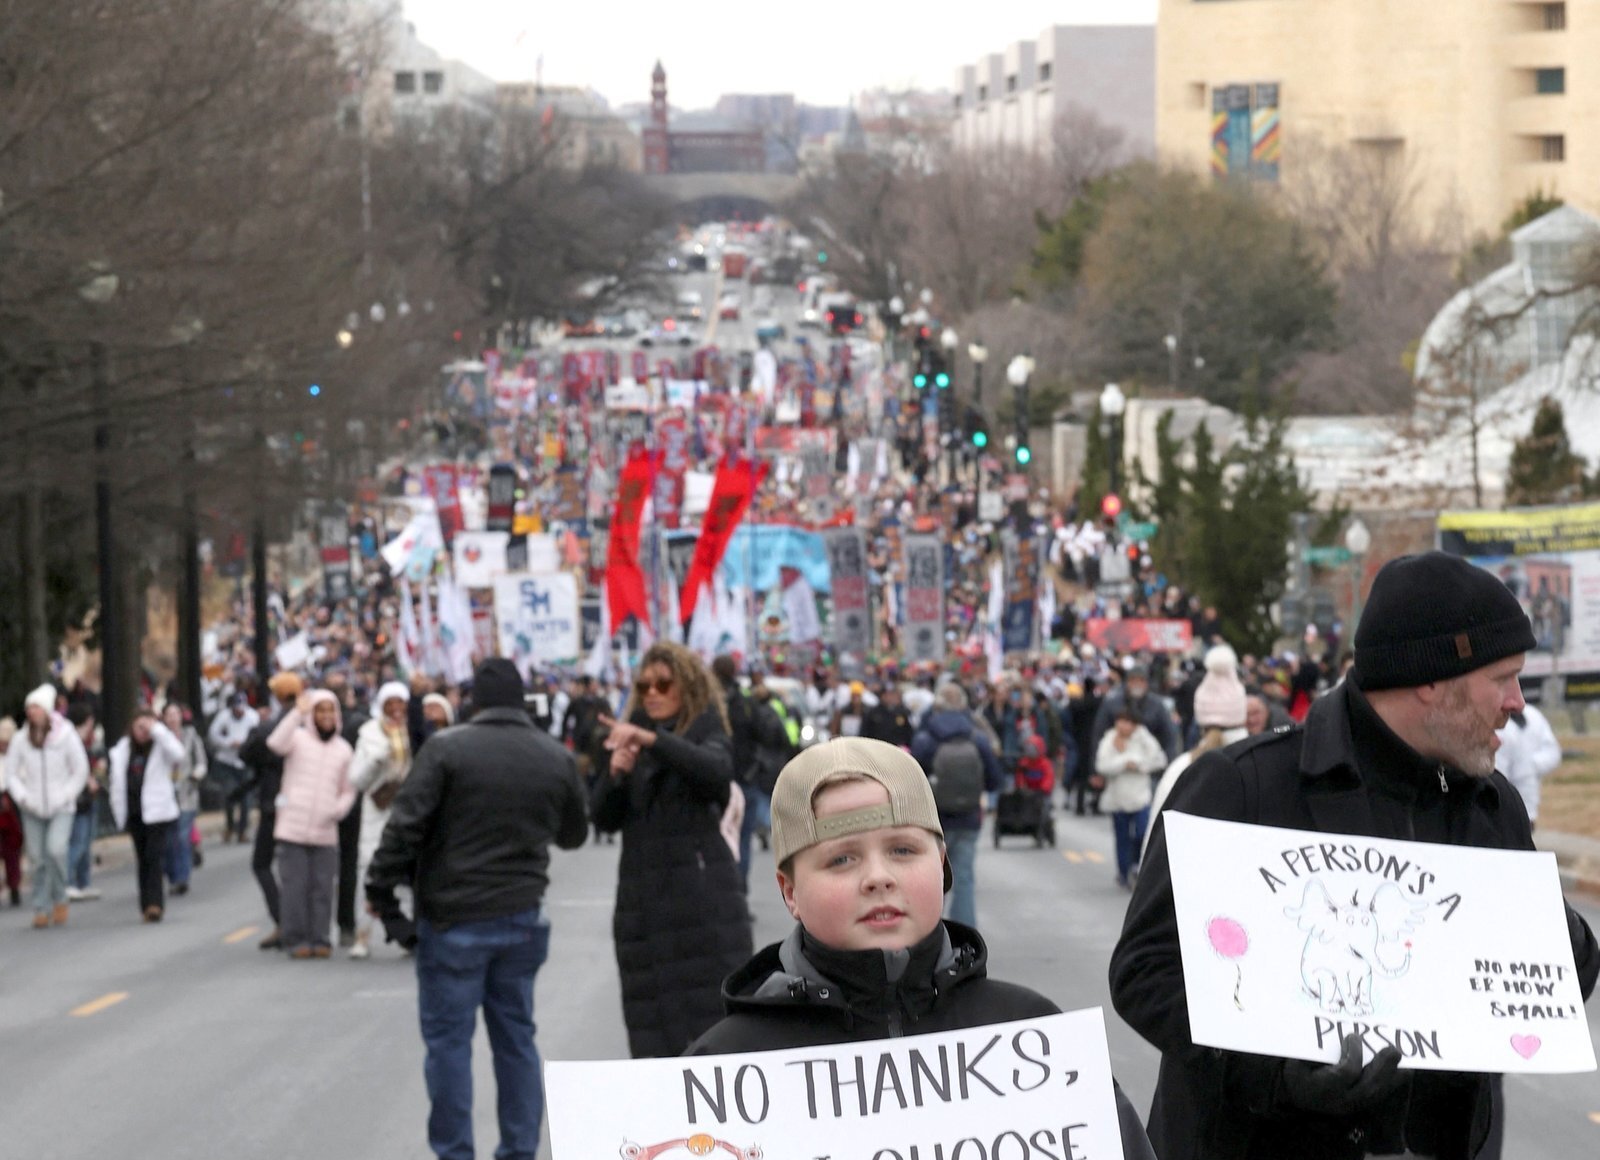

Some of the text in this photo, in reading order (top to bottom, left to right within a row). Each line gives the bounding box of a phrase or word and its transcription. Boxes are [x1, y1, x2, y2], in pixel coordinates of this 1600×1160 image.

[1259, 842, 1463, 922] A PERSON'S A
[1474, 959, 1504, 974] NO
[1469, 977, 1556, 997] ER HOW
[1490, 1001, 1578, 1021] SMALL!
[682, 1027, 1080, 1125] NO THANKS,
